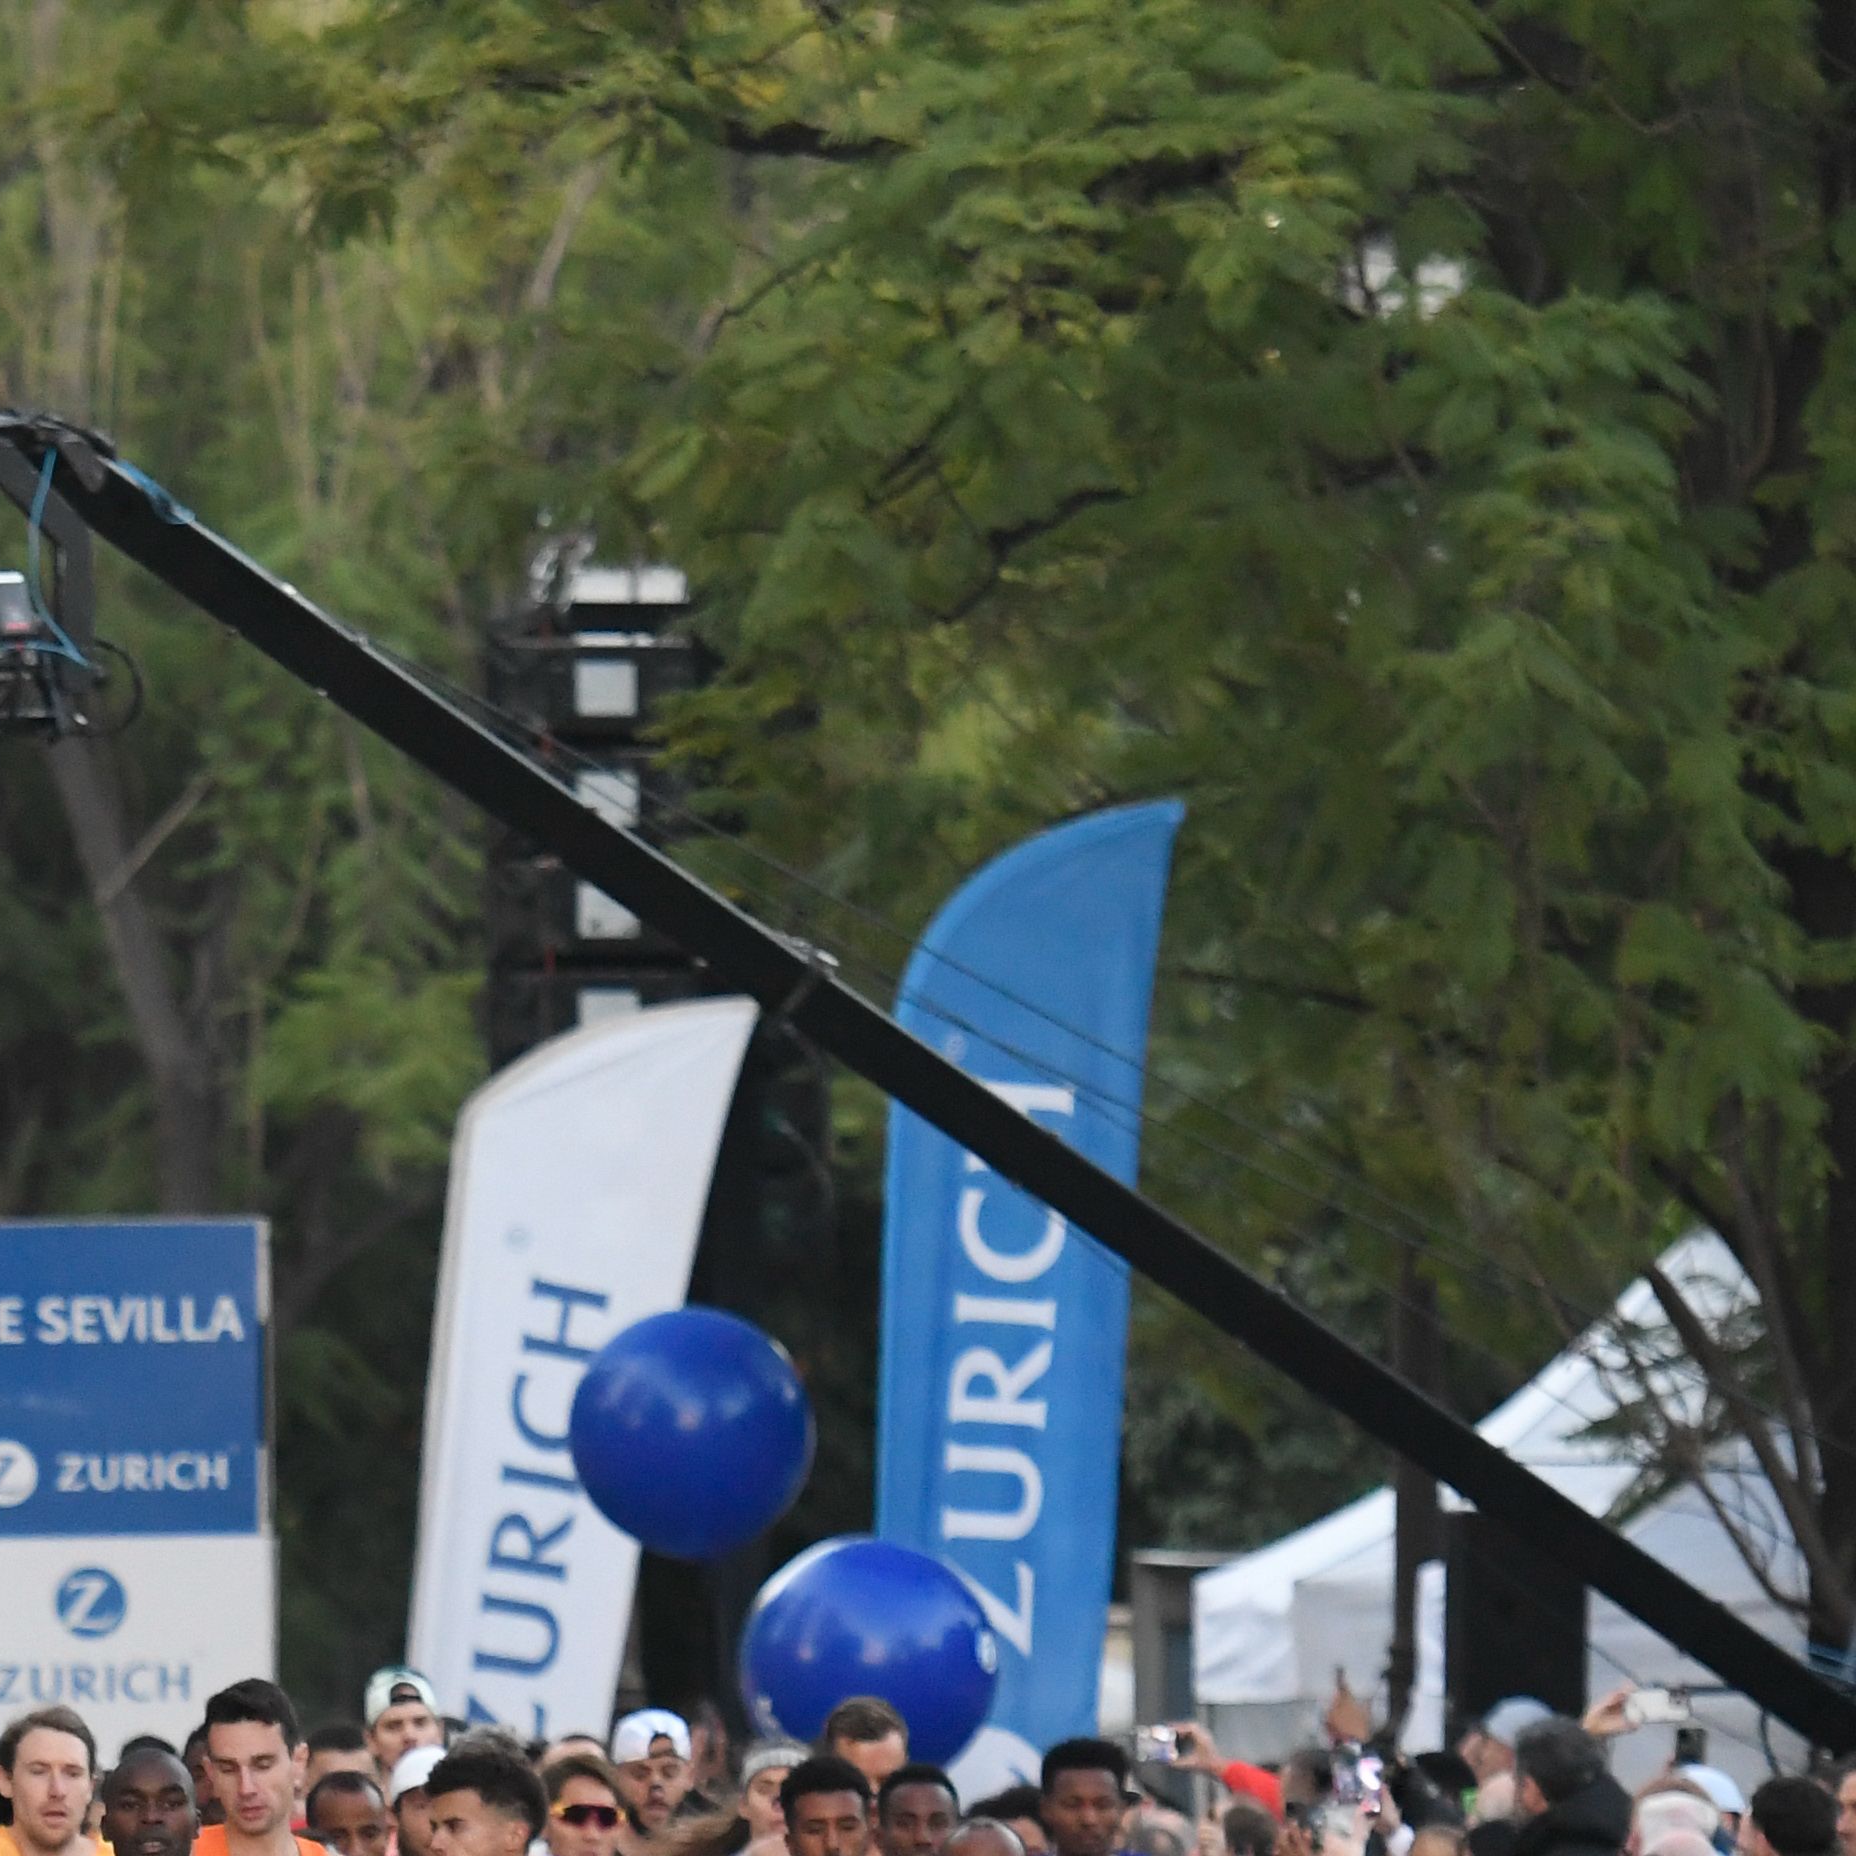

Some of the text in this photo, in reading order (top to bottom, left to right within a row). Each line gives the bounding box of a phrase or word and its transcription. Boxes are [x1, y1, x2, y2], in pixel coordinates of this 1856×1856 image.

[35, 1294, 245, 1344] SEVILLA
[936, 1083, 1075, 1657] ZURIC
[54, 1450, 229, 1493] ZURICH
